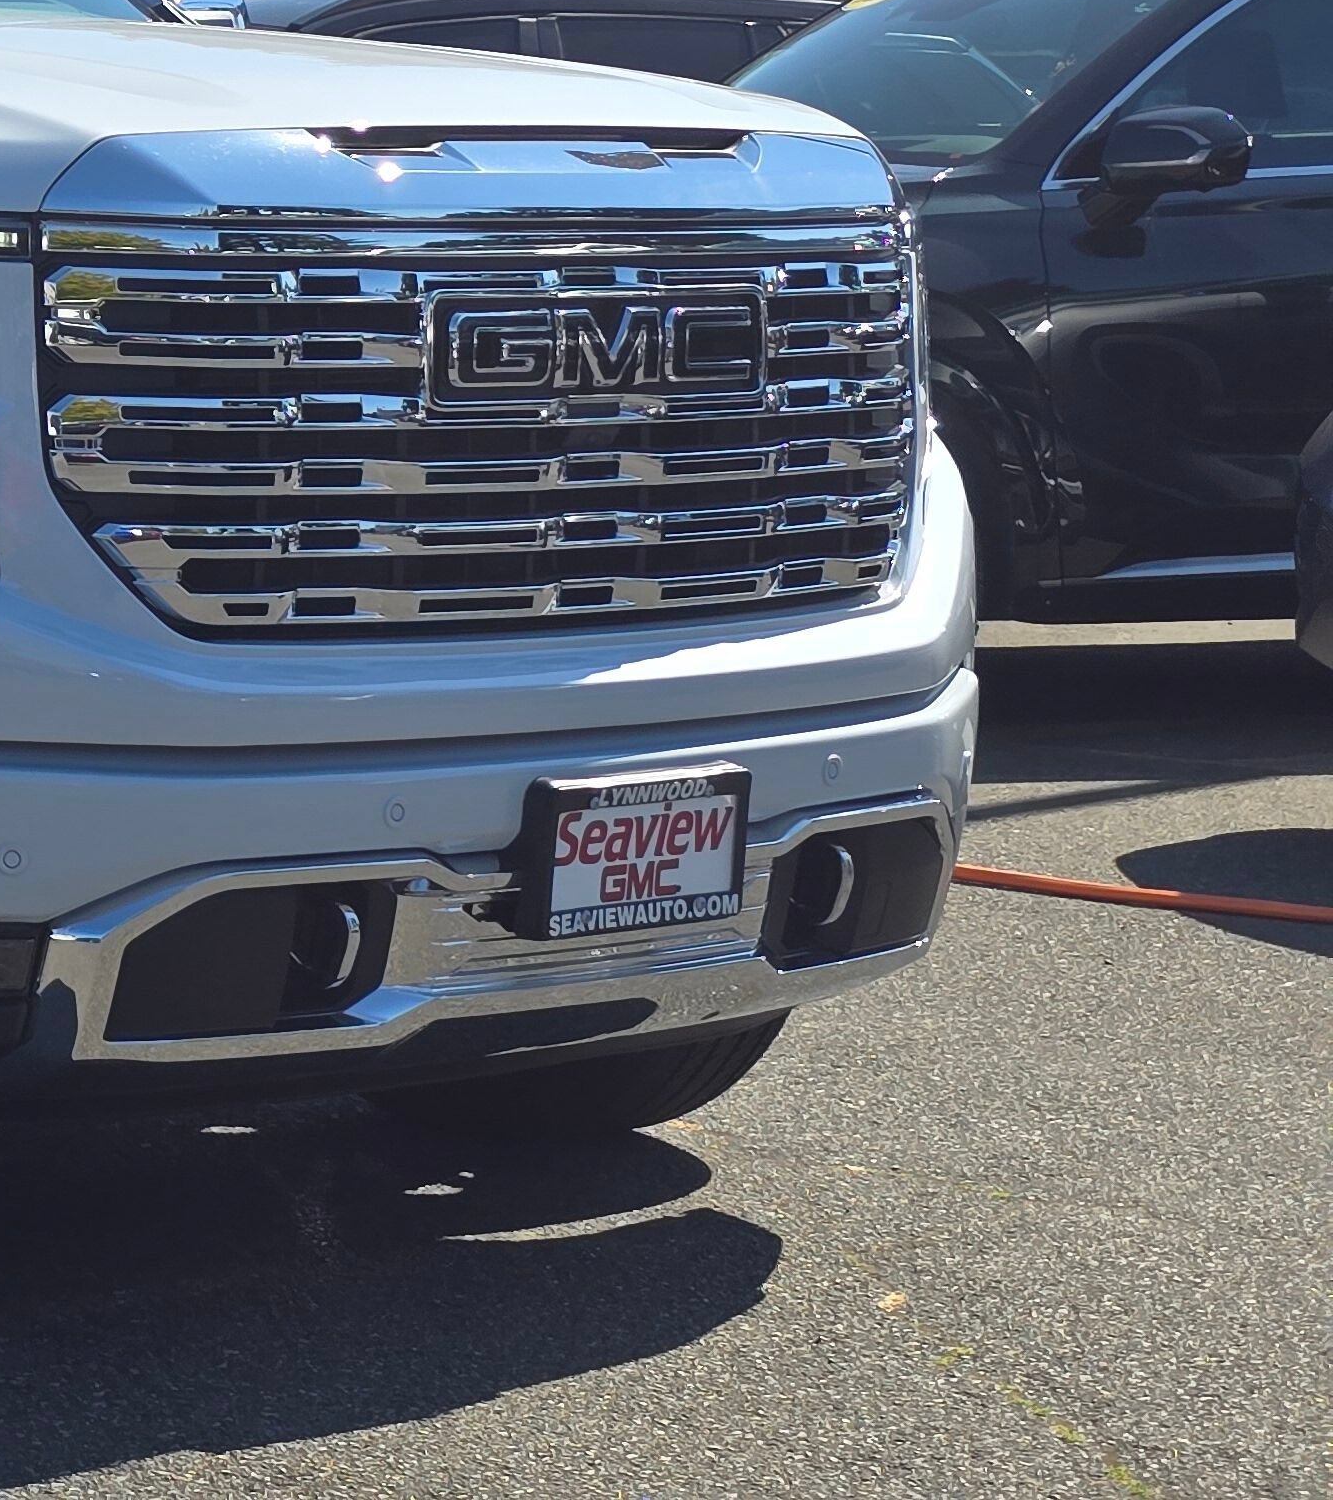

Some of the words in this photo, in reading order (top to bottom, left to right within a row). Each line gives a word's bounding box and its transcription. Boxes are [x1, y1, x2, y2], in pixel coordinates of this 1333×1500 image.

[449, 306, 752, 388] GMC
[598, 778, 708, 807] LYNNWOOD
[553, 802, 733, 867] Seaview
[600, 858, 681, 903] GMC
[549, 893, 739, 937] SEAVIEWAUTO.COM
